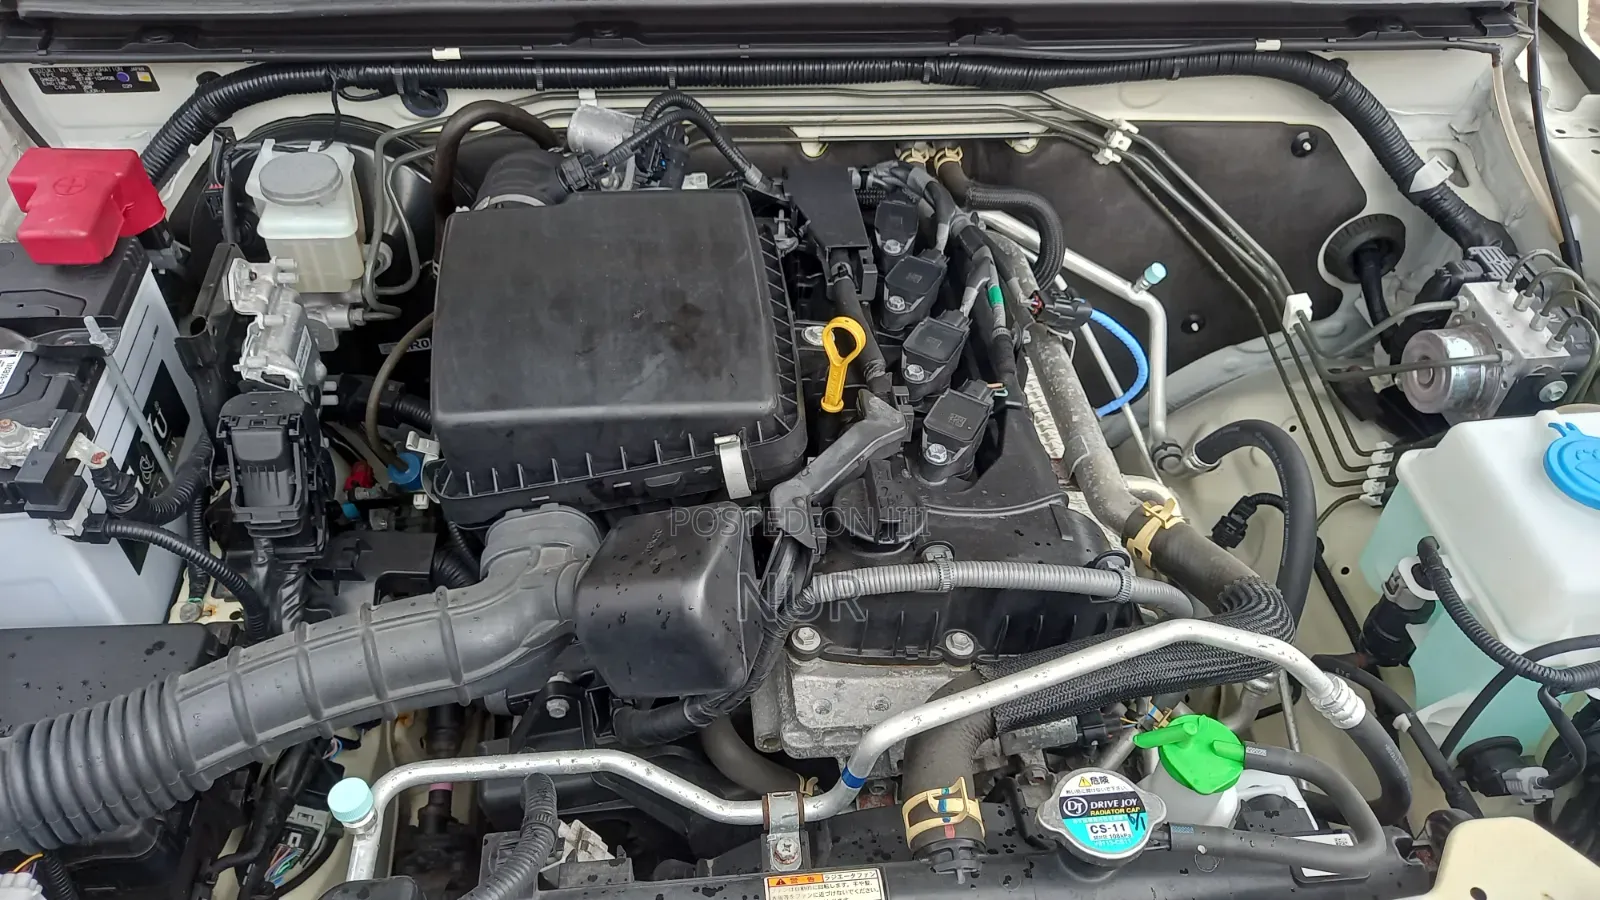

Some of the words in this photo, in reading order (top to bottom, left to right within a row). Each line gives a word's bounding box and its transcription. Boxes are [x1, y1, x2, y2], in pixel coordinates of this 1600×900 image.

[1090, 776, 1110, 785] 危険
[1090, 800, 1119, 809] DRIVE
[1121, 798, 1138, 807] JOY
[1090, 808, 1125, 816] RADIATOR
[1090, 823, 1126, 834] CS-11
